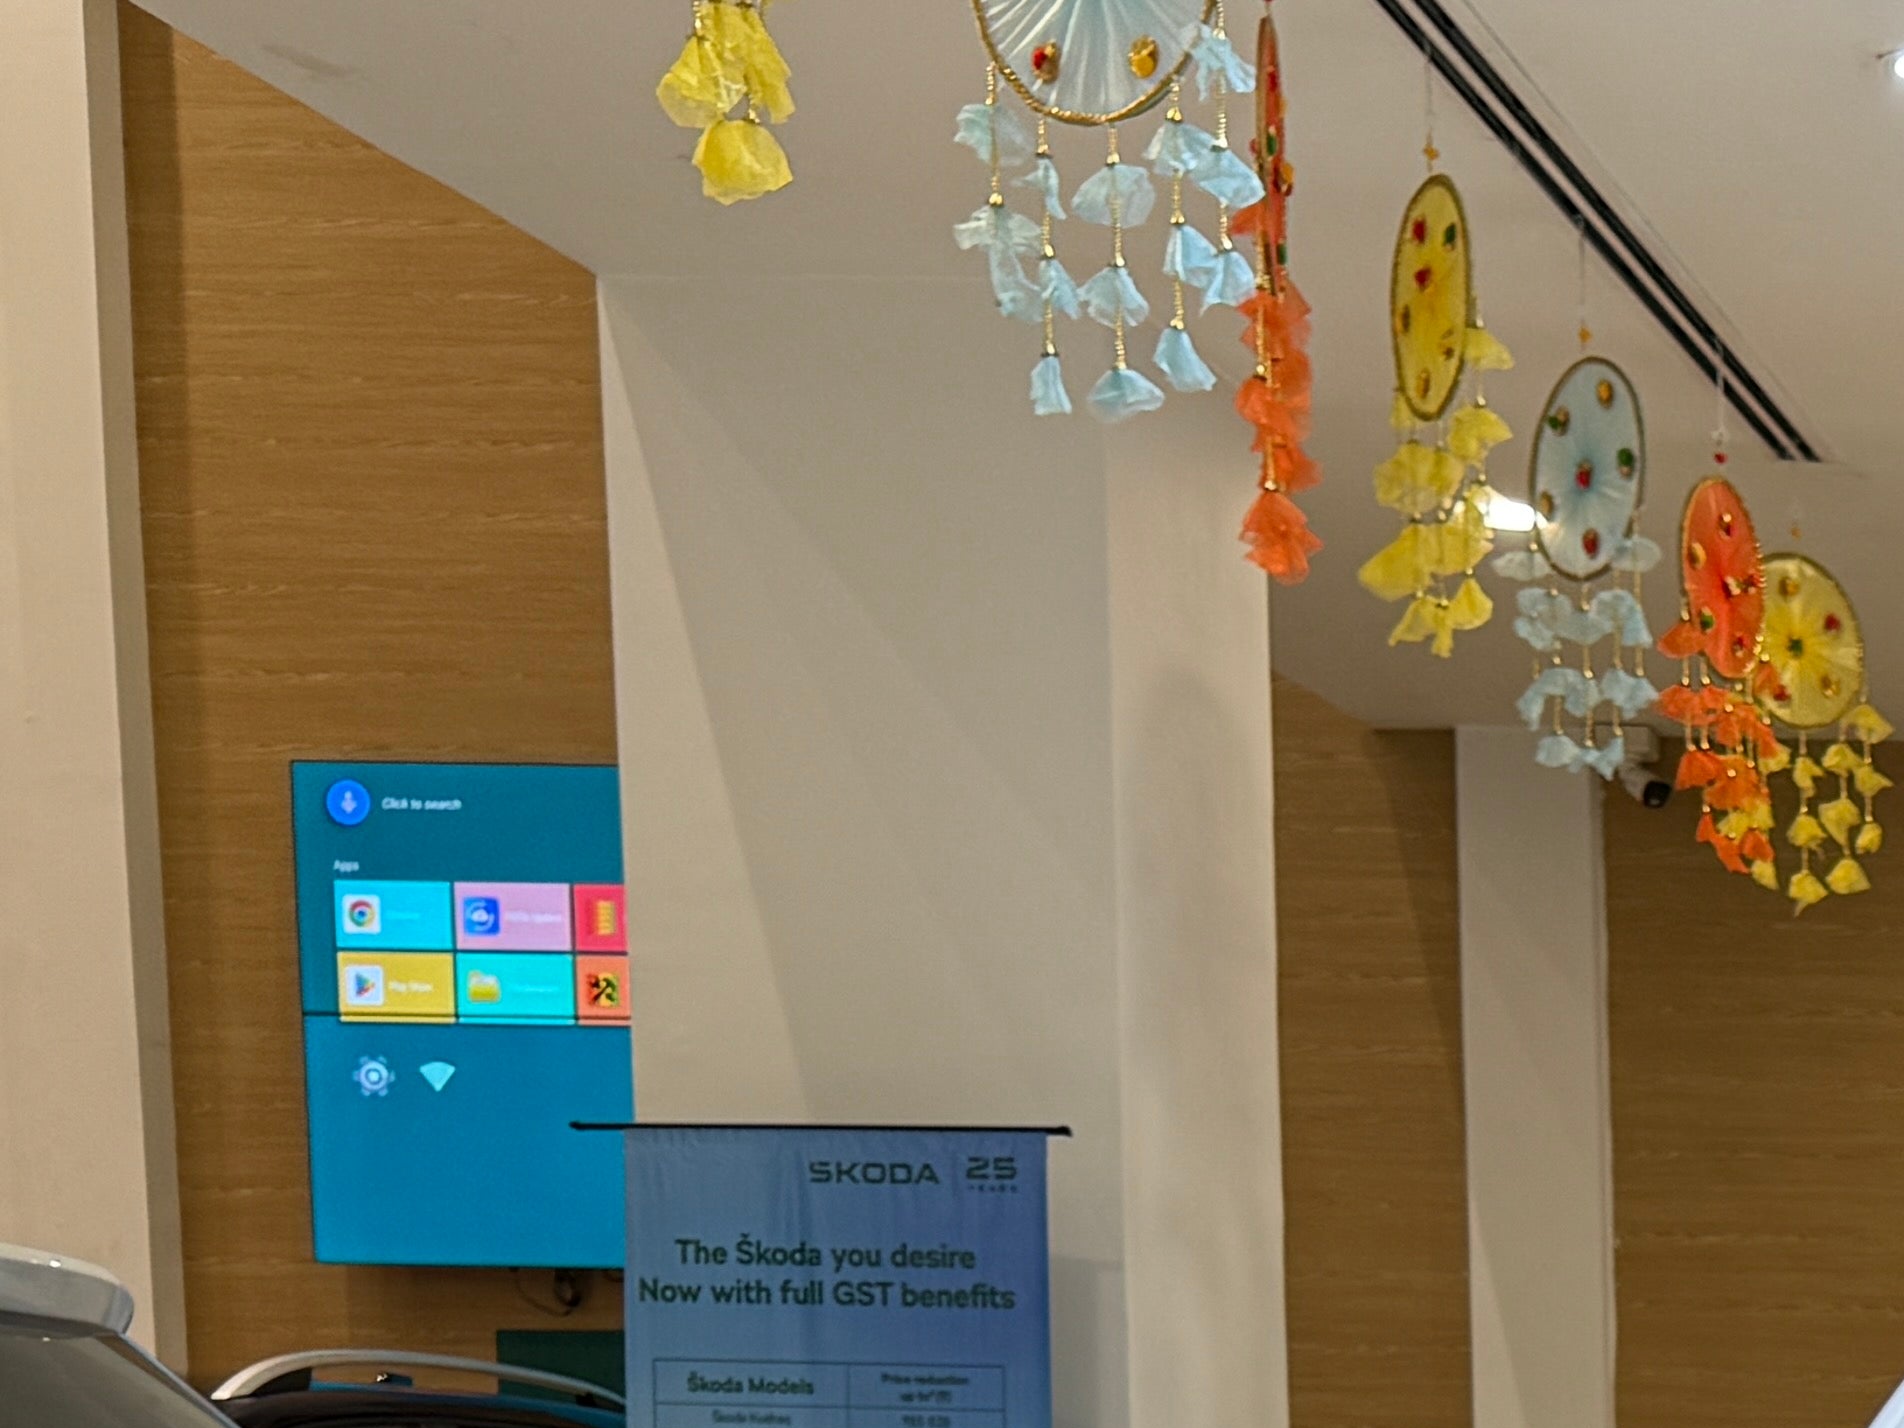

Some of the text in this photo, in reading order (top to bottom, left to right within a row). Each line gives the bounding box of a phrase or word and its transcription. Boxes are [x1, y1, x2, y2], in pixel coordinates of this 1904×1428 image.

[381, 796, 462, 811] Click to search
[333, 859, 360, 873] Apps
[809, 1156, 1018, 1185] SKODA 25
[674, 1232, 976, 1273] The Škoda you desire
[638, 1277, 1016, 1310] Now with full GST benefits
[687, 1370, 814, 1396] Škoda Models
